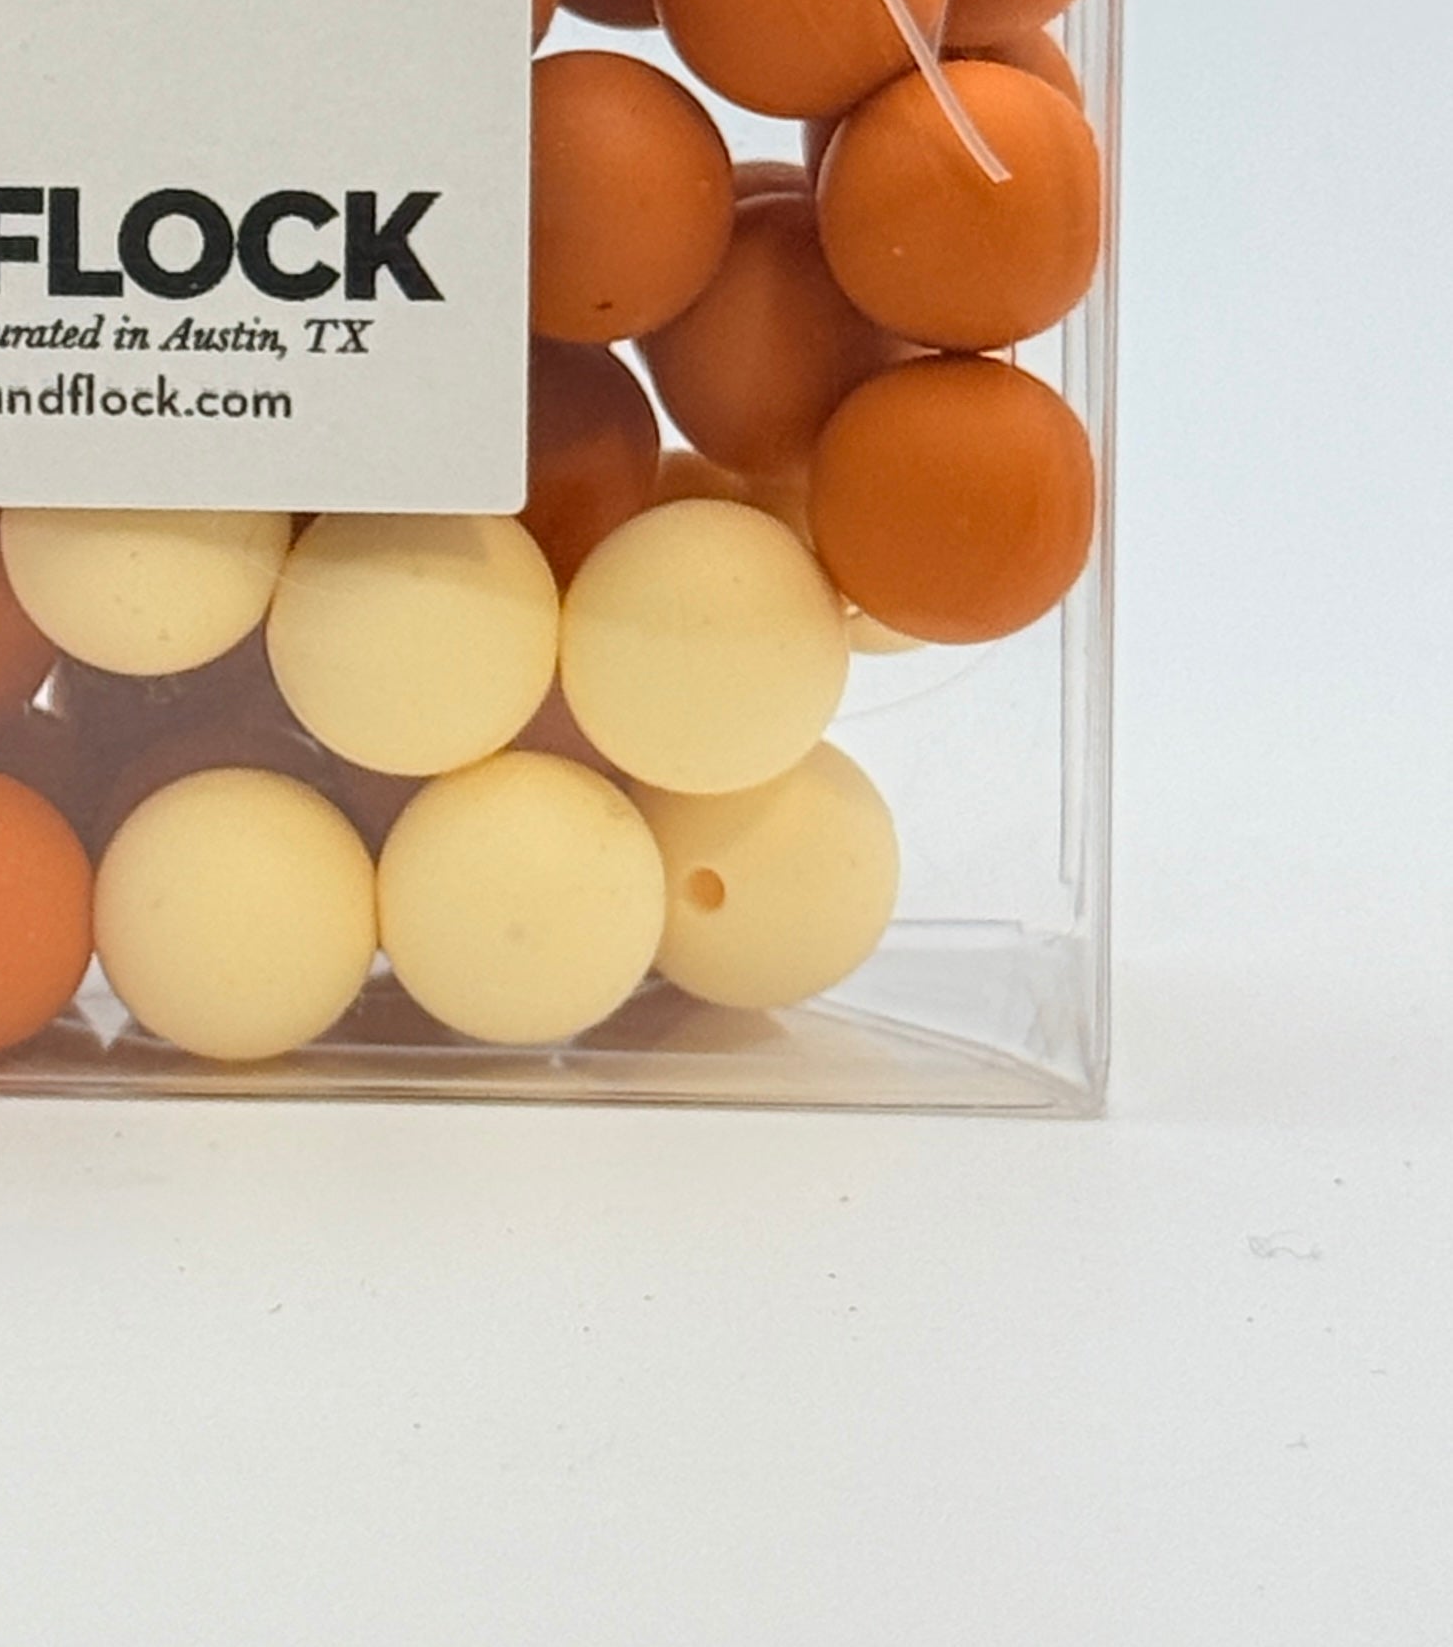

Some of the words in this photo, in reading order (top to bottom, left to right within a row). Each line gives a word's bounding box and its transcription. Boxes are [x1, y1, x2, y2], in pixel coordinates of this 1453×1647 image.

[113, 314, 151, 351] in
[157, 316, 288, 361] Austin,
[303, 318, 375, 354] TX
